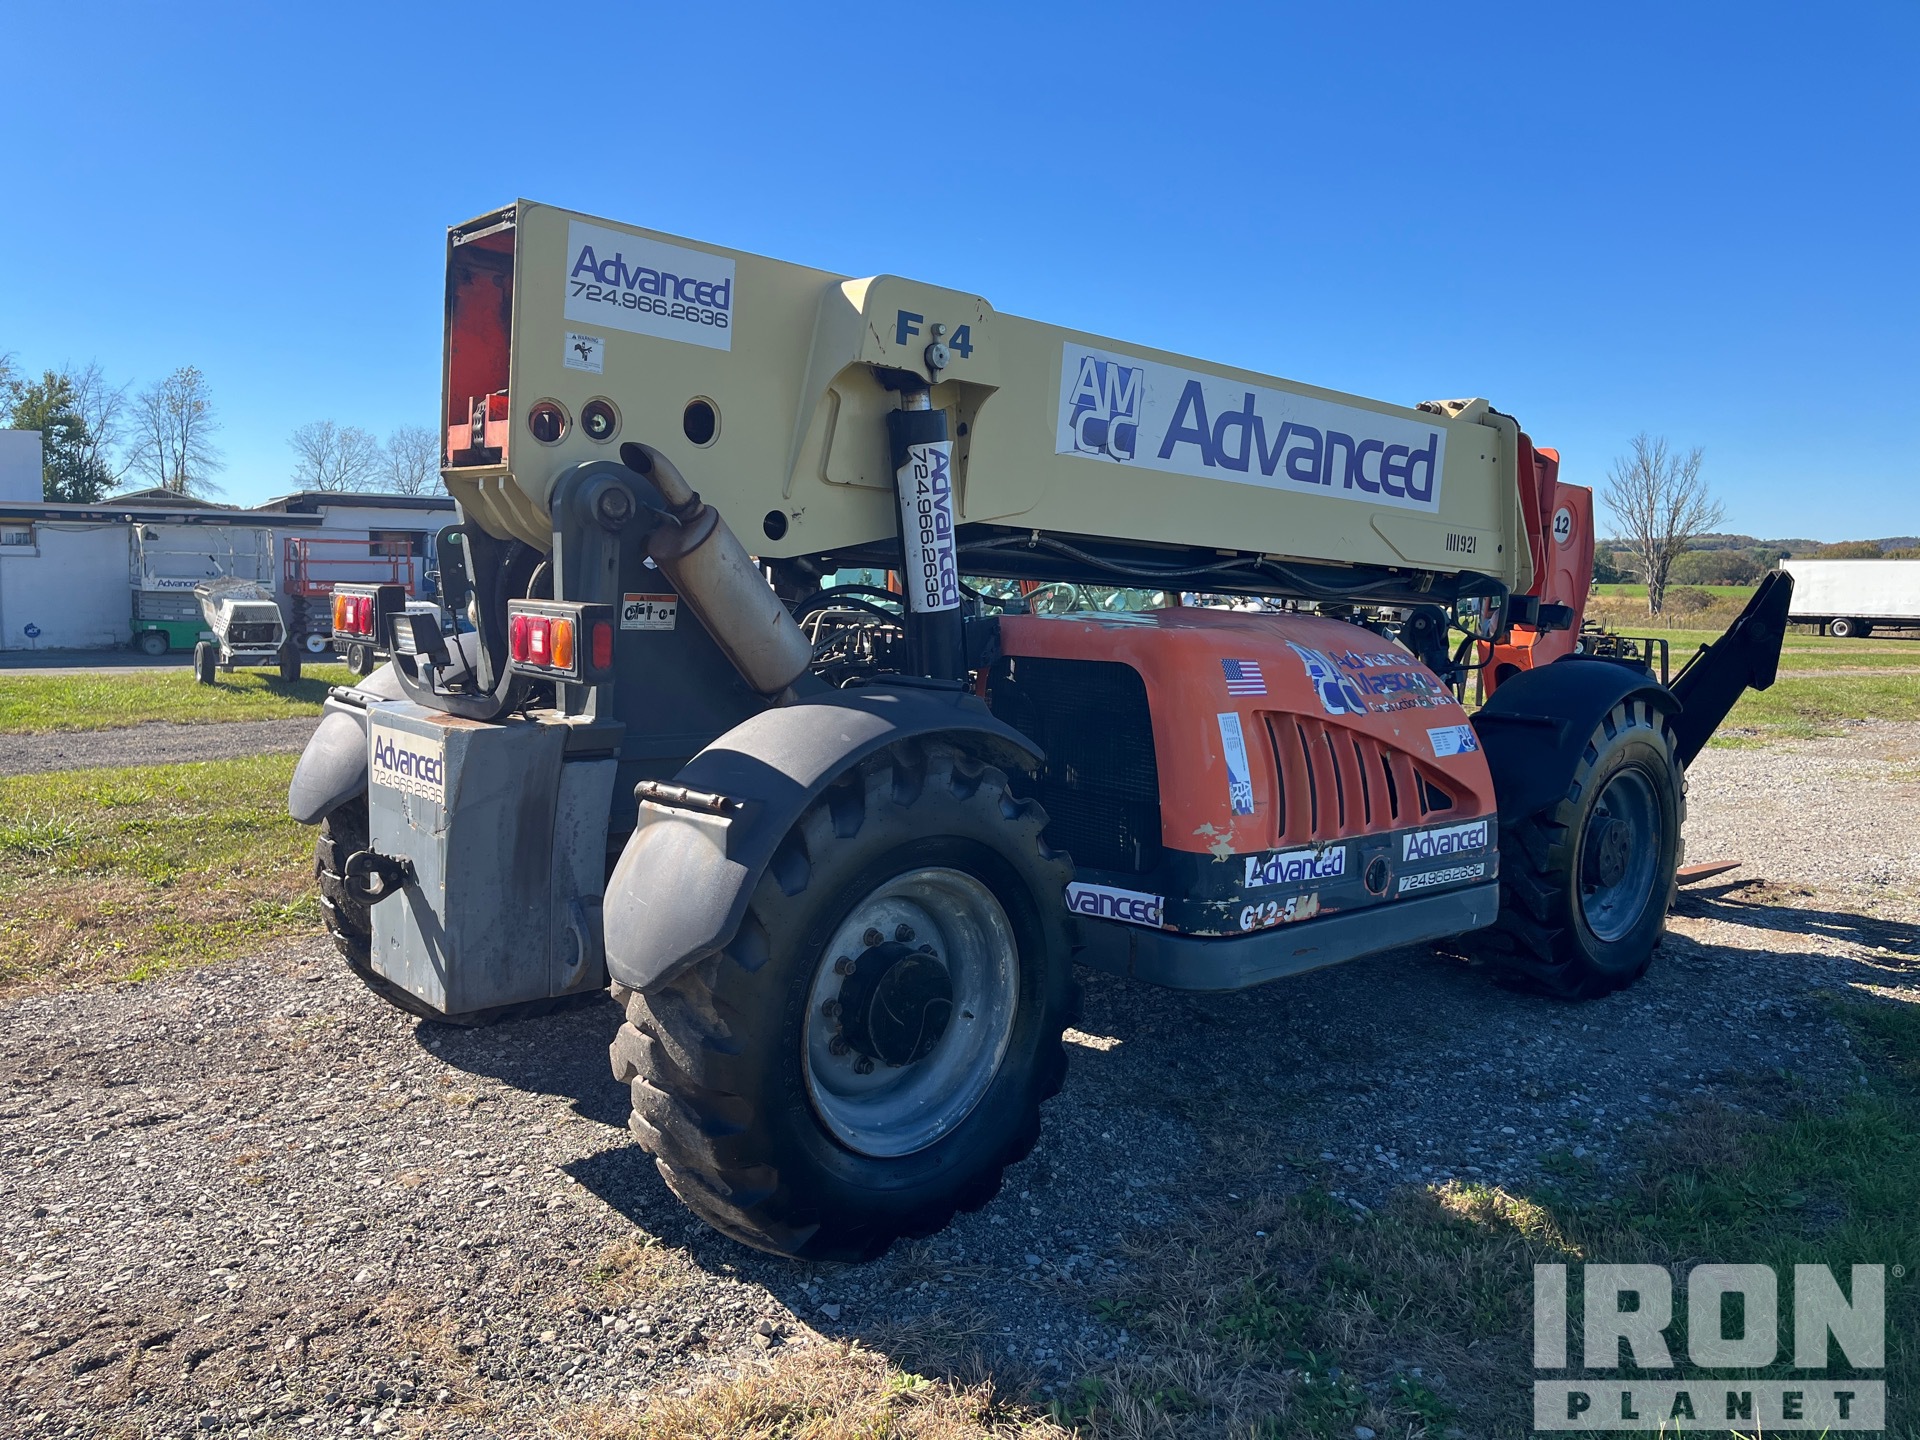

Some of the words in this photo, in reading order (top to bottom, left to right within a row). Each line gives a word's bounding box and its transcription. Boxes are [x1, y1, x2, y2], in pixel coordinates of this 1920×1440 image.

[571, 245, 730, 310] Advanced
[570, 280, 729, 329] 724.966.2636
[895, 309, 924, 346] F
[1157, 379, 1438, 502] Advanced
[912, 448, 940, 608] 724.966.2636
[928, 447, 959, 607] Advanced
[1553, 515, 1570, 535] 12
[374, 734, 443, 786] Advanced
[1406, 822, 1486, 861] Advanced
[1248, 850, 1343, 886] Advanced
[1065, 889, 1160, 926] vanced
